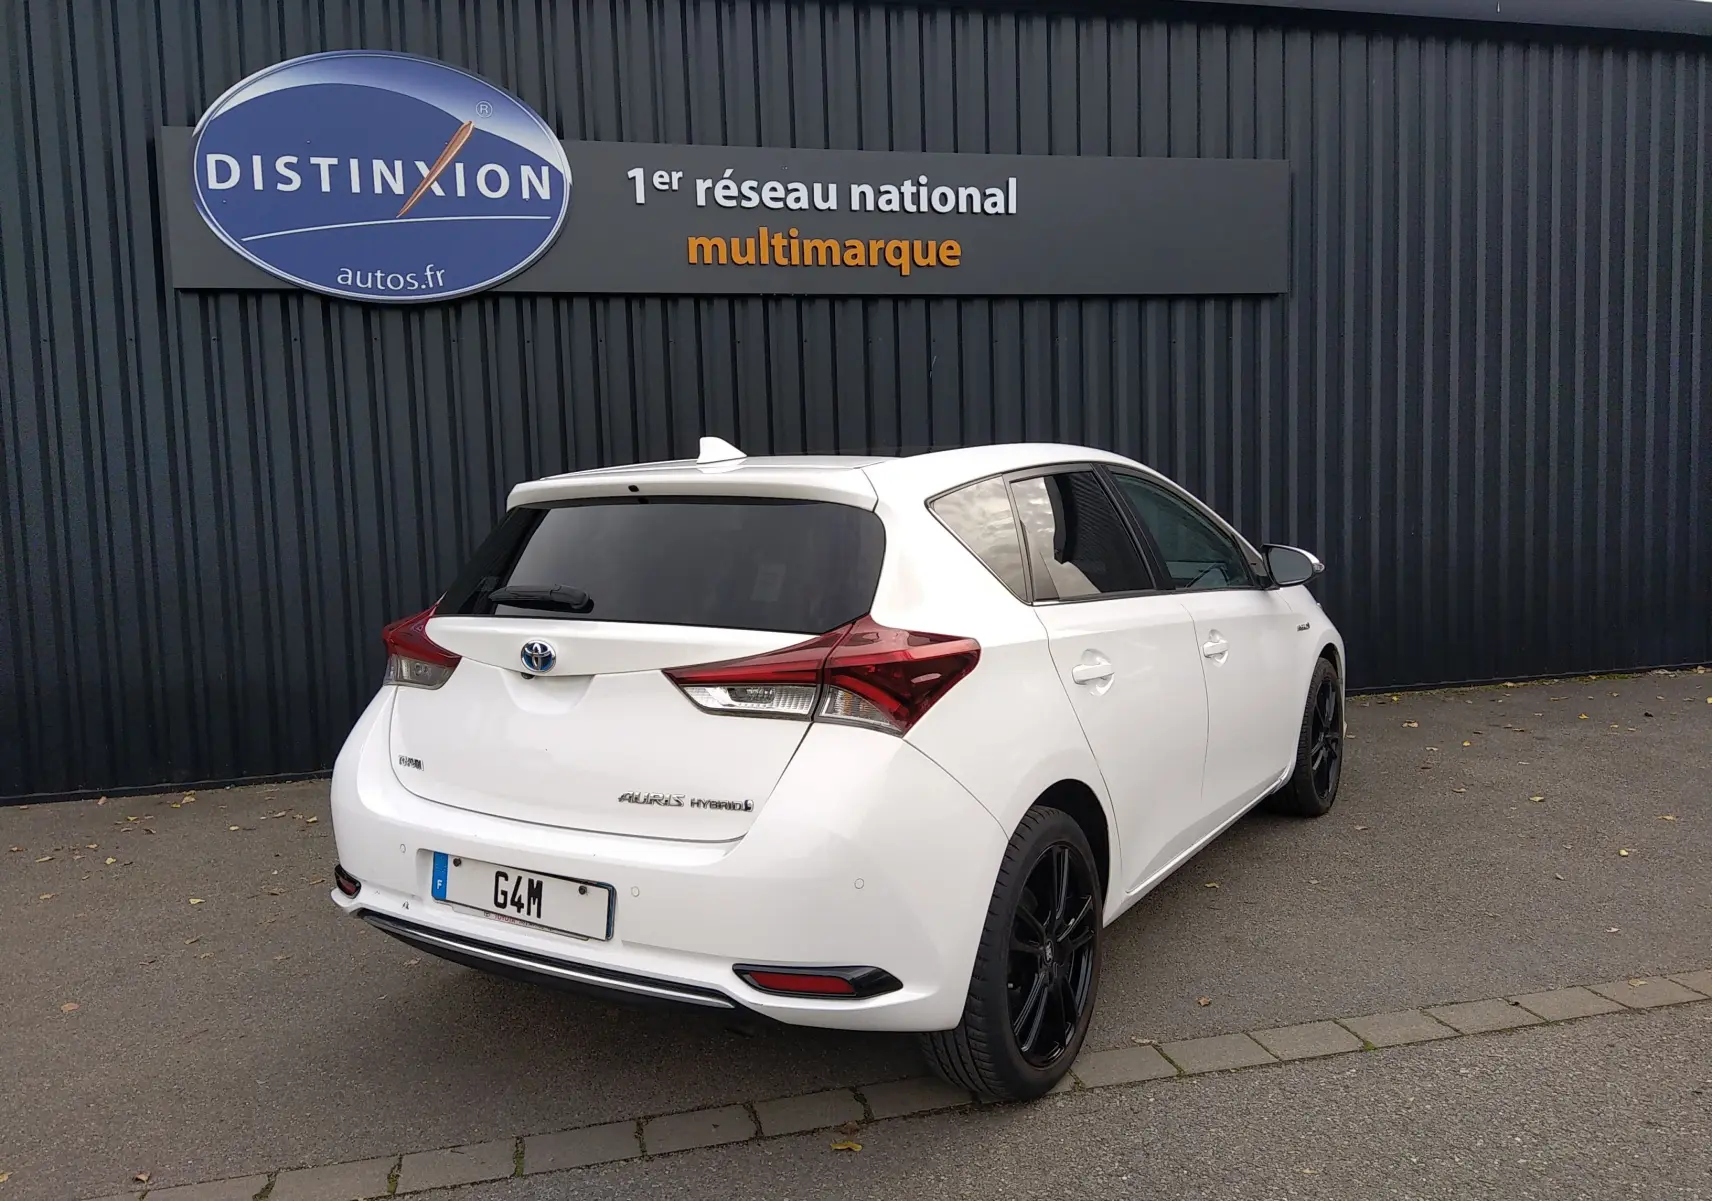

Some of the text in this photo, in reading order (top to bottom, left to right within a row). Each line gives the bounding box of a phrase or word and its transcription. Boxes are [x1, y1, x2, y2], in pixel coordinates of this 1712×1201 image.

[205, 153, 551, 200] DISTINXION
[627, 166, 1018, 214] 1er réseau national
[687, 226, 962, 275] multimarque
[337, 264, 445, 291] autos.fr
[618, 791, 746, 811] AURIS HYBRID
[436, 879, 443, 890] F
[494, 870, 543, 919] G4M
